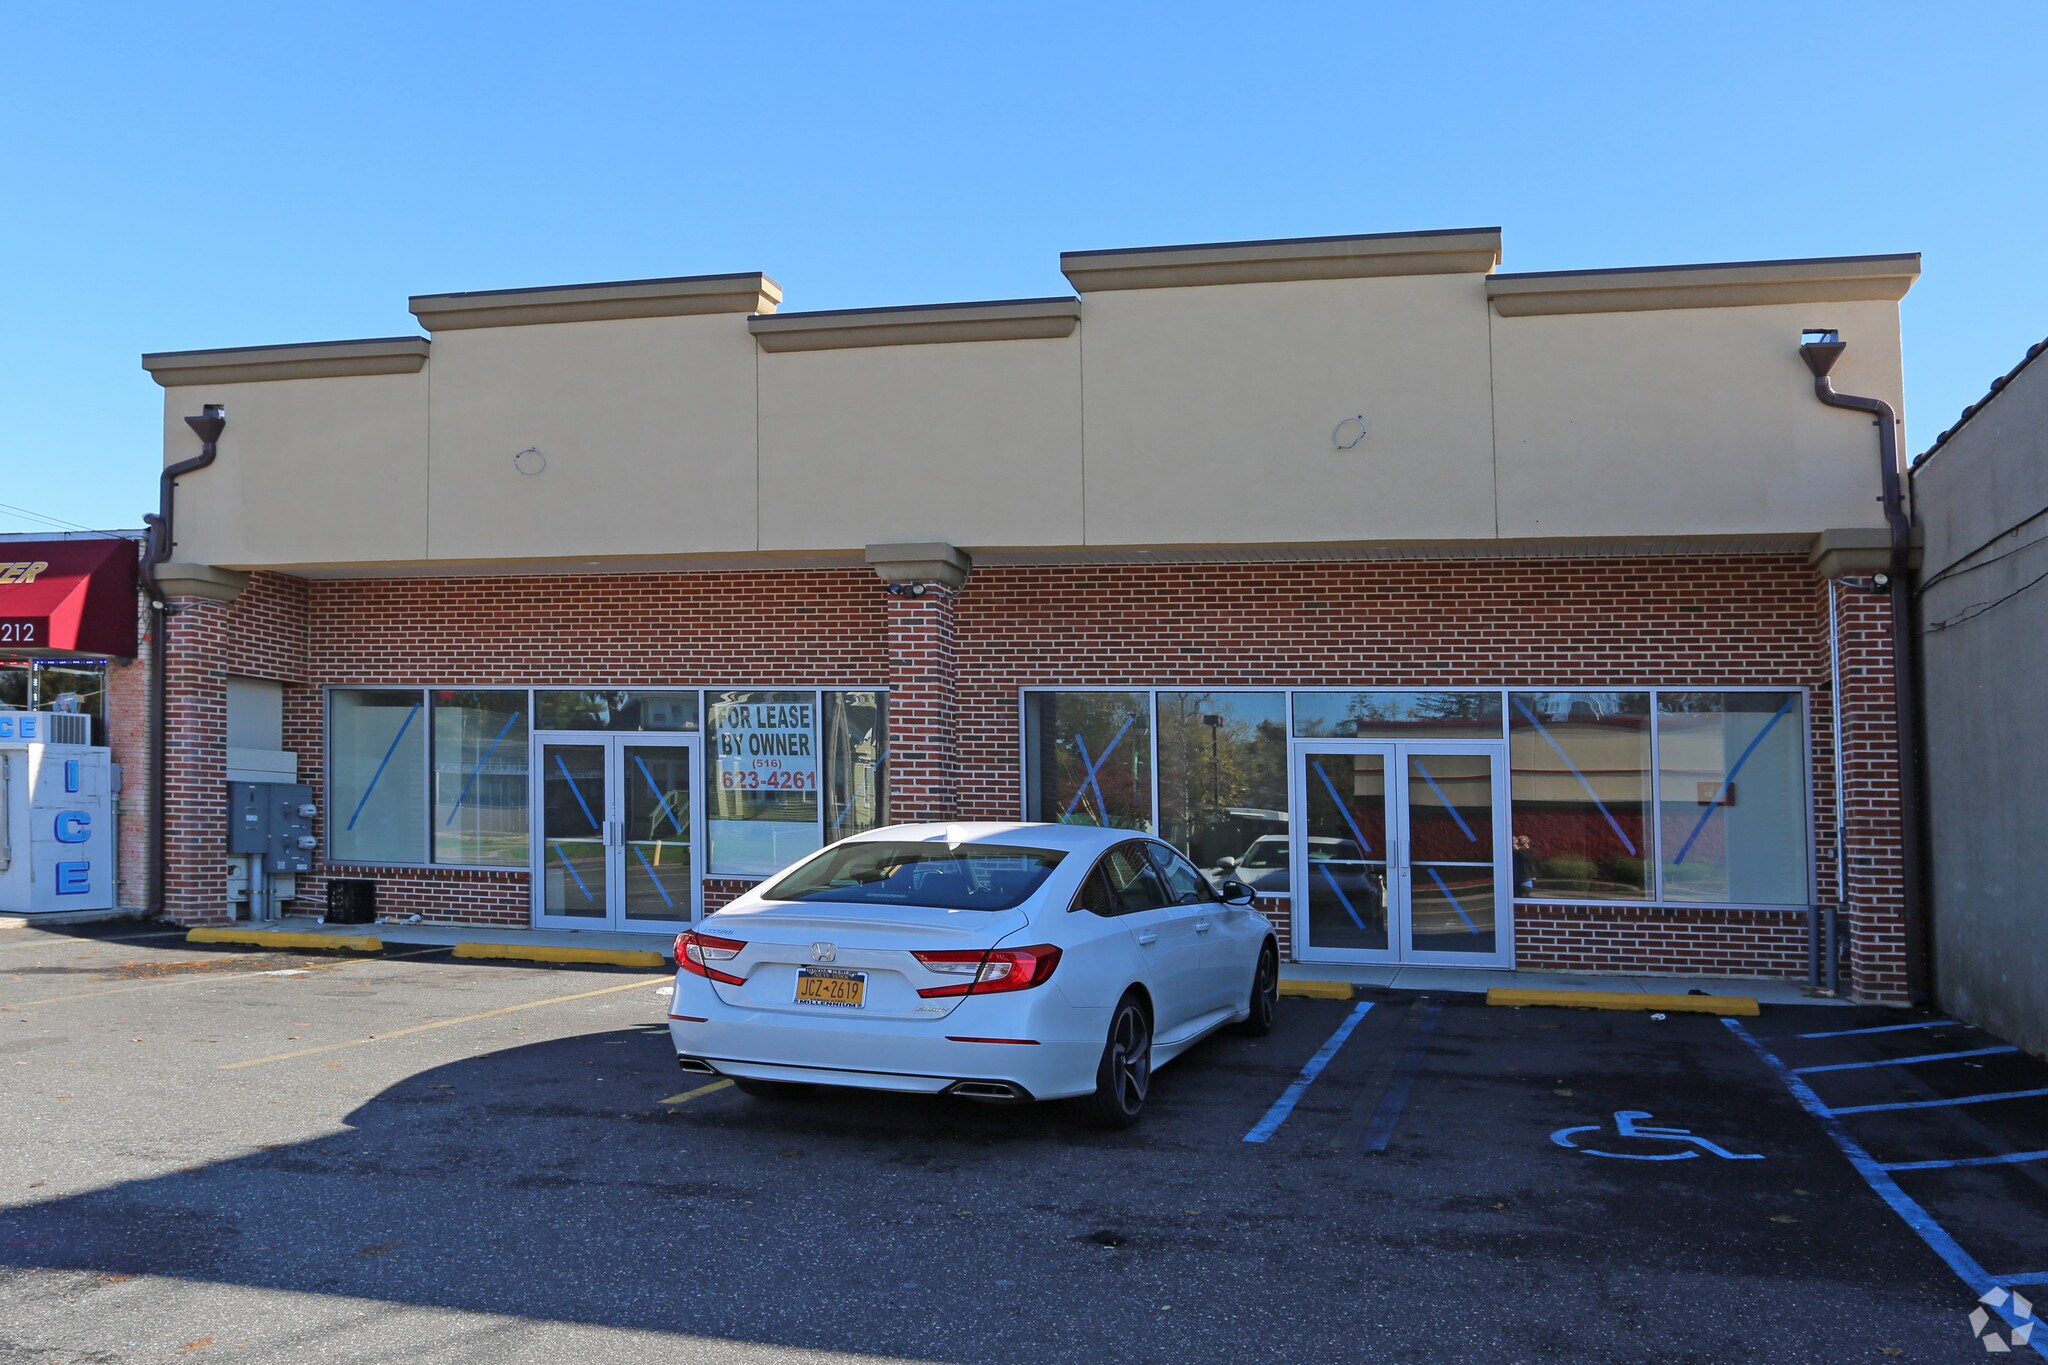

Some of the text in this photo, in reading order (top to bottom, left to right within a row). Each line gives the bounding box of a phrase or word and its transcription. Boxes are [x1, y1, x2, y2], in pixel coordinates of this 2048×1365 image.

[1, 623, 34, 641] 212
[718, 705, 811, 729] FOR LEASE
[721, 733, 811, 756] BY OWNER
[752, 759, 783, 769] (516)
[722, 771, 816, 789] 623-4261
